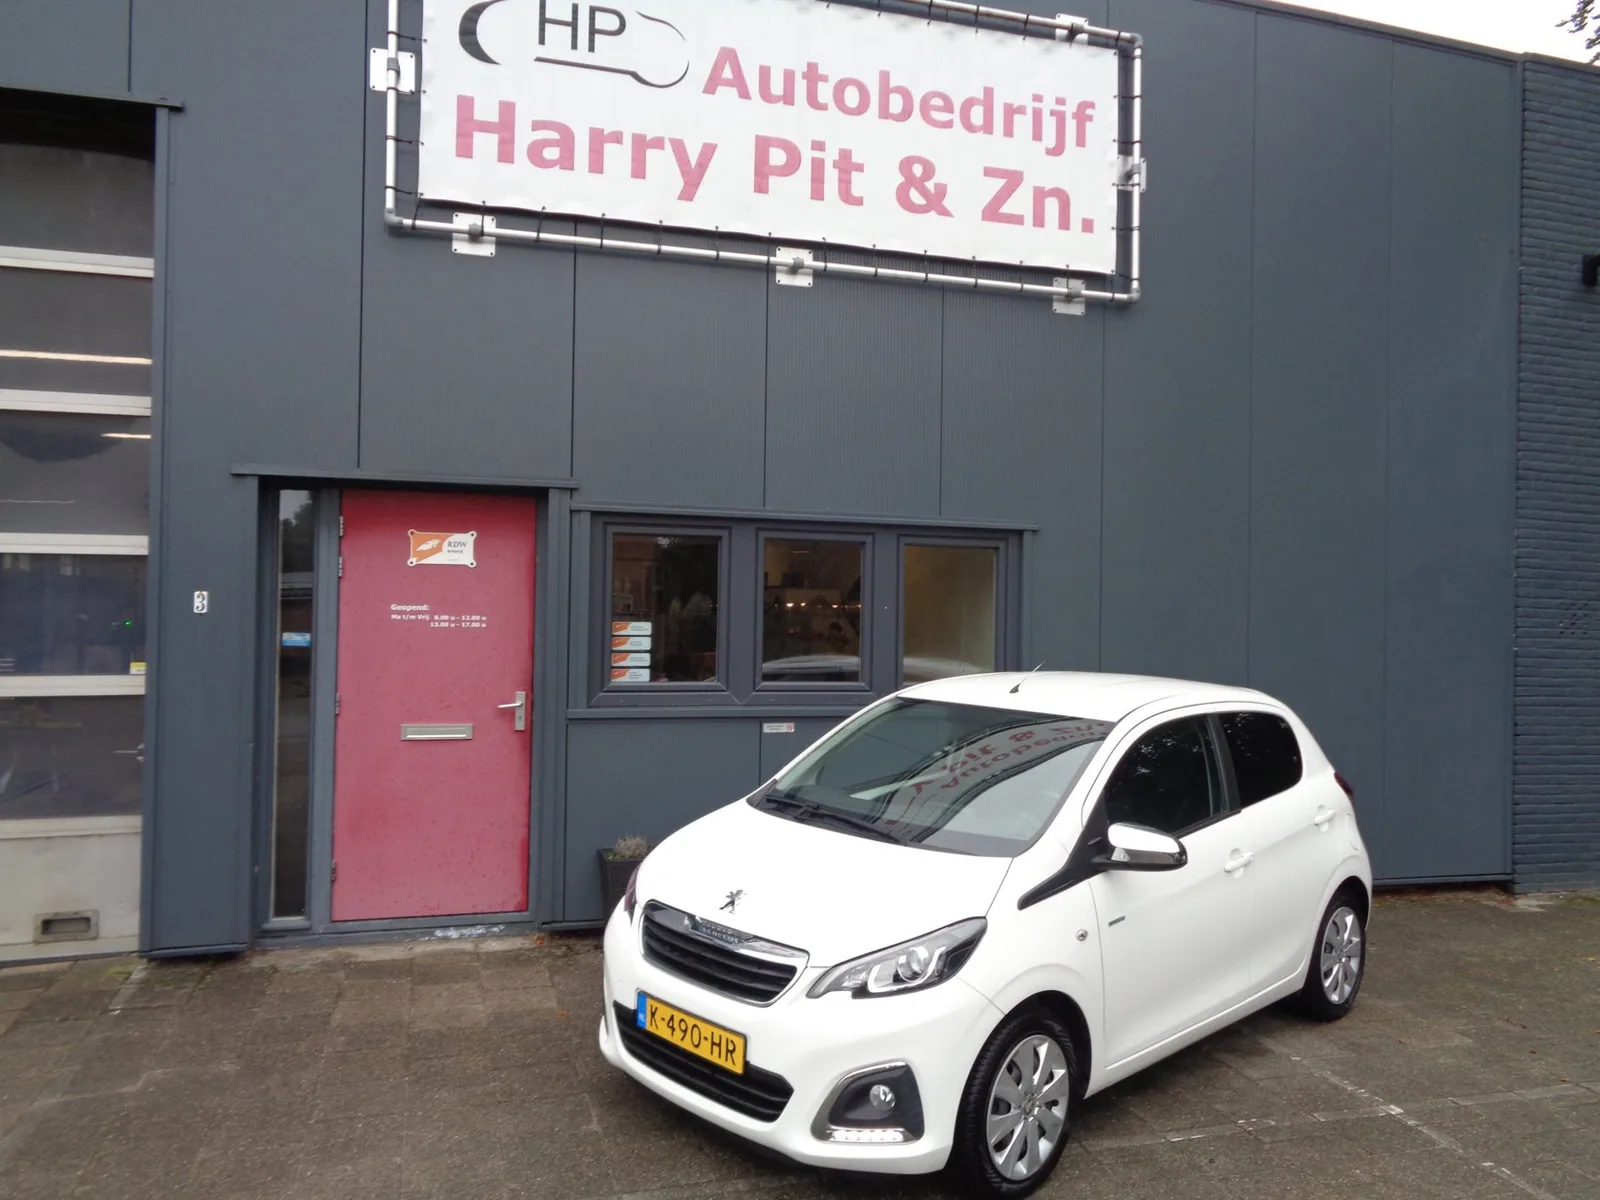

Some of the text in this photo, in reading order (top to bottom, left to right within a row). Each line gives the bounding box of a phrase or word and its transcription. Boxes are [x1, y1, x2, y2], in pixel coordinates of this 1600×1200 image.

[538, 0, 627, 53] HP
[703, 48, 1095, 156] Autobedrijf
[456, 96, 1095, 233] Harry Pit & Zn.
[196, 592, 206, 612] 3
[390, 603, 430, 612] Geopend:
[649, 1003, 737, 1067] K-490-HR
